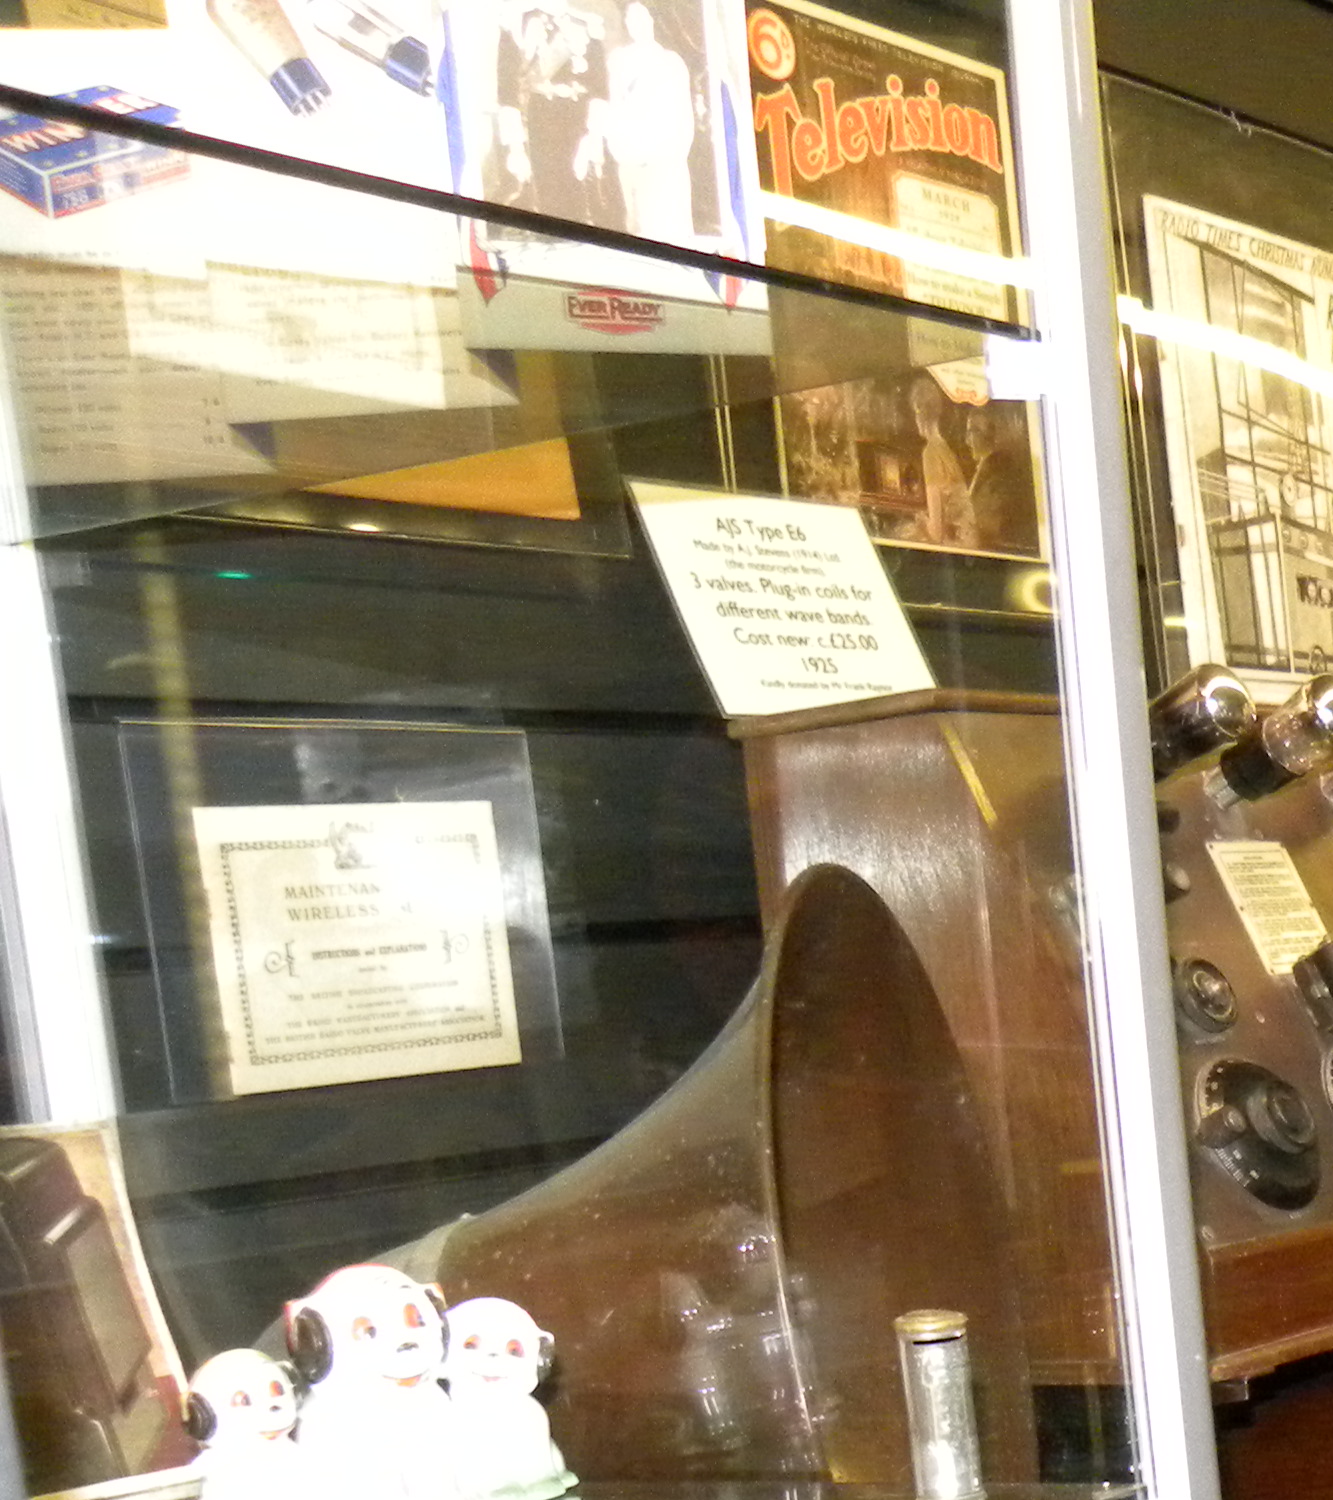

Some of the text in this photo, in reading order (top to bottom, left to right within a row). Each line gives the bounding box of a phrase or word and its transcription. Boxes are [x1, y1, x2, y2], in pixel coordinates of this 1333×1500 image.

[755, 74, 1003, 228] Television
[1161, 210, 1200, 242] RADIO
[1205, 224, 1242, 252] TIMES
[1249, 237, 1304, 271] CHRISTMAS
[716, 517, 806, 542] AJS Type E6
[690, 572, 702, 589] 3
[760, 578, 811, 601] Plug-in
[816, 585, 848, 600] coils
[851, 585, 872, 602] for
[716, 602, 781, 622] different
[786, 610, 824, 624] wave
[734, 627, 773, 646] Cost
[802, 657, 838, 674] 1925
[287, 903, 380, 922] WIRELESS
